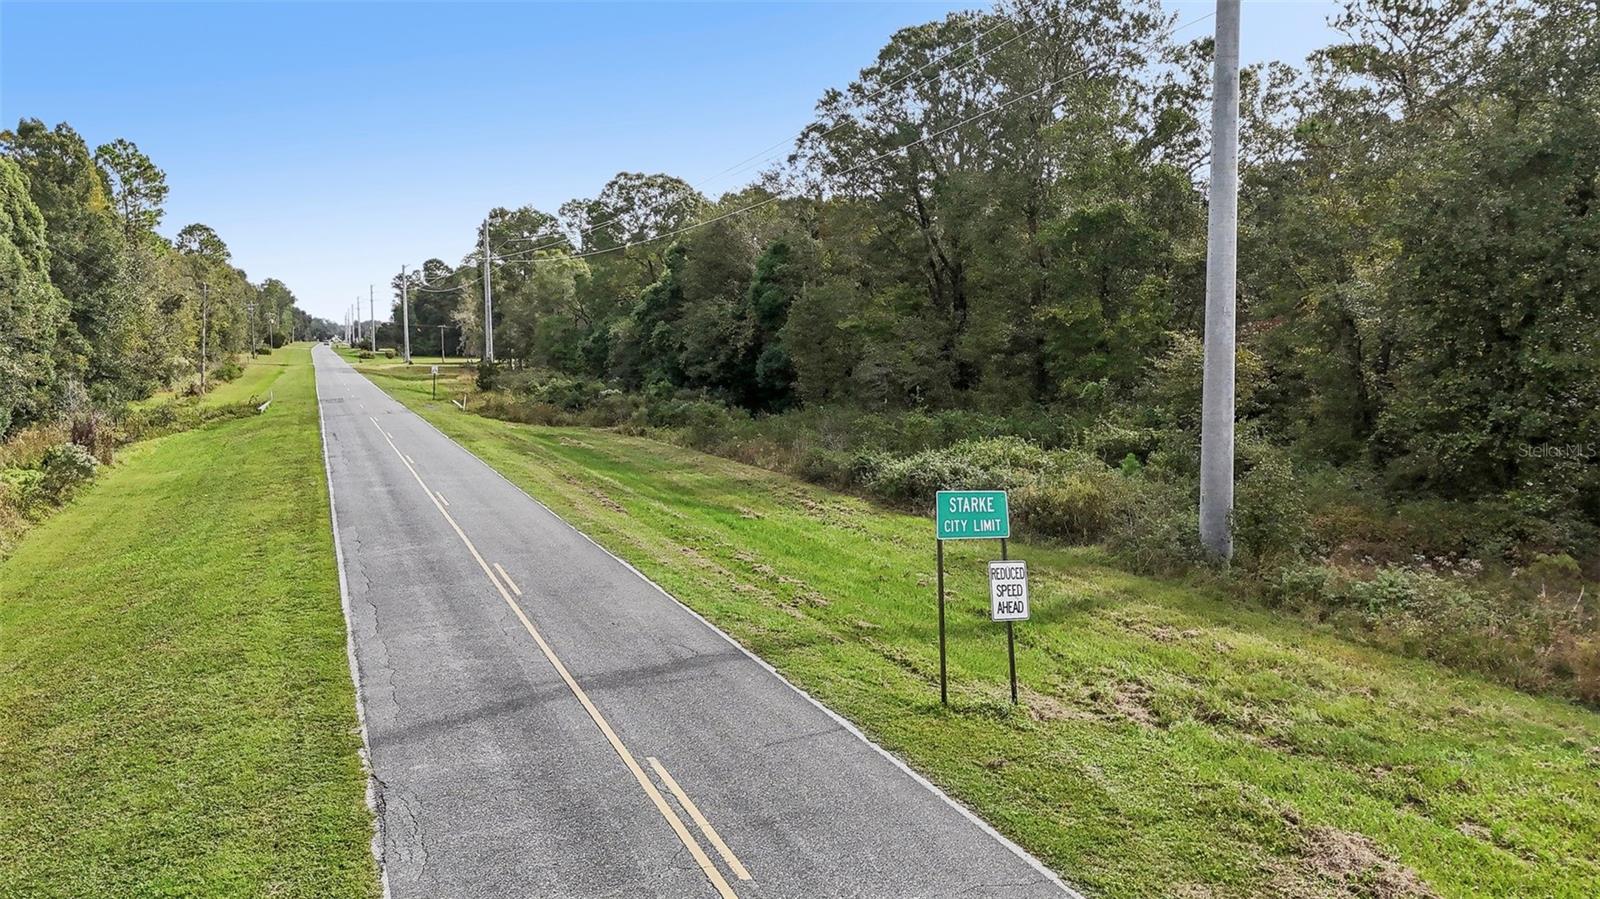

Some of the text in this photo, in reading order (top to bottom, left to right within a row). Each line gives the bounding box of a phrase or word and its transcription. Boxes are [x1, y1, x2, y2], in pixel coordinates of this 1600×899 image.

[949, 497, 995, 513] STARKE
[944, 519, 1001, 533] CITY LIMIT
[991, 567, 1025, 580] REDUCED
[996, 584, 1023, 597] SPEED
[997, 601, 1024, 614] AHEAD
